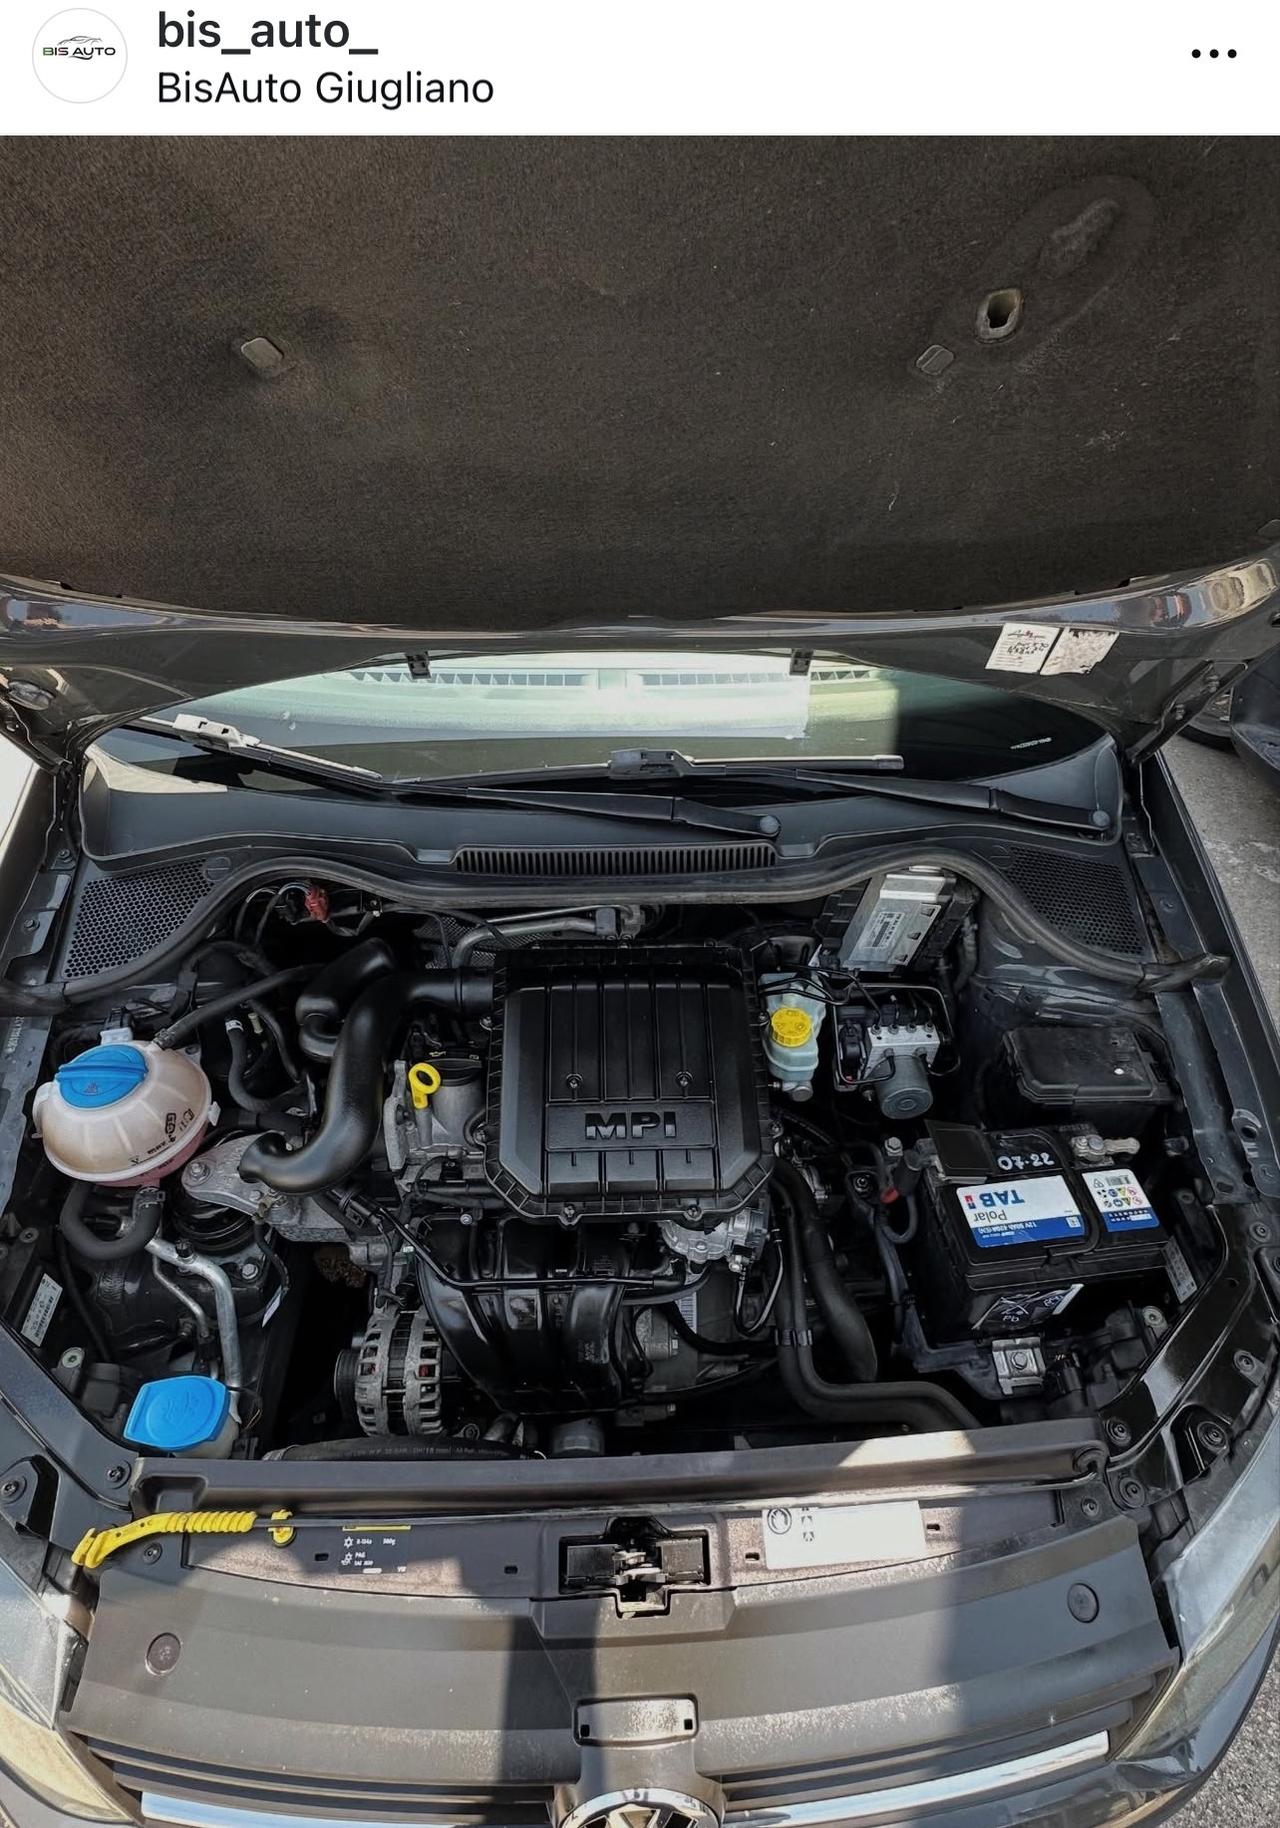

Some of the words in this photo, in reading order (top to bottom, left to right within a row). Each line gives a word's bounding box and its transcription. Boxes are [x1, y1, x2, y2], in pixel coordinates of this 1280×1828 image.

[585, 1111, 676, 1140] MPI
[979, 1189, 1025, 1207] TAB
[973, 1209, 1008, 1222] Polar
